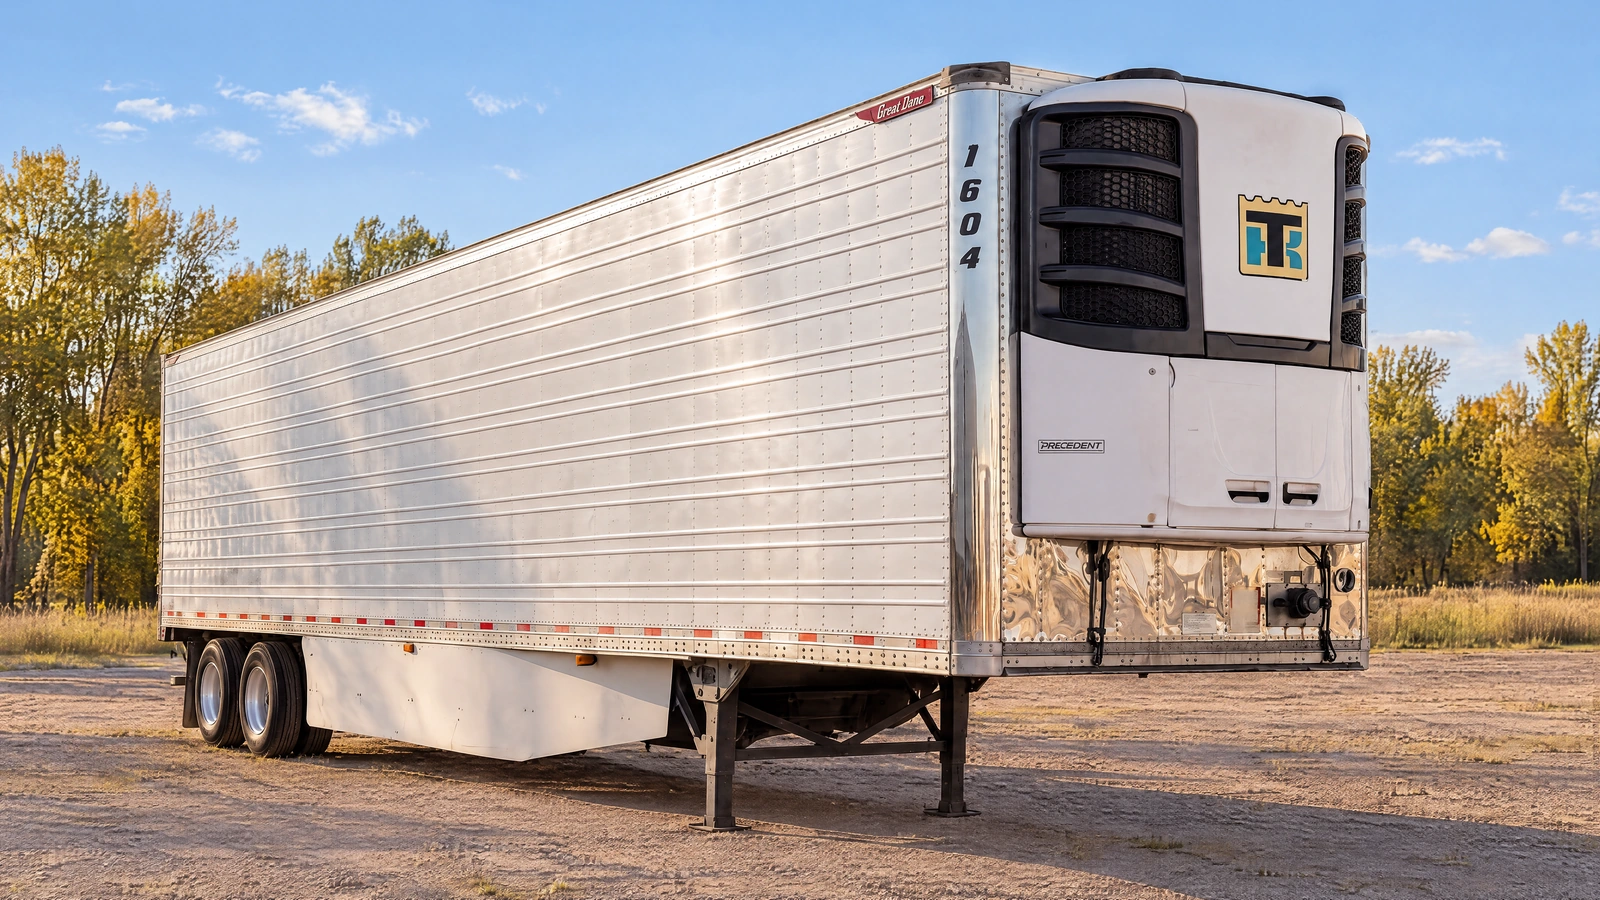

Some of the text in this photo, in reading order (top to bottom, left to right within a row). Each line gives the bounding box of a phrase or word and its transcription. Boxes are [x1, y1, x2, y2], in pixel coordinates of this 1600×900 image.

[877, 95, 924, 120] Great Dane
[960, 144, 982, 269] 1604
[1040, 441, 1103, 450] PRECEDENT
